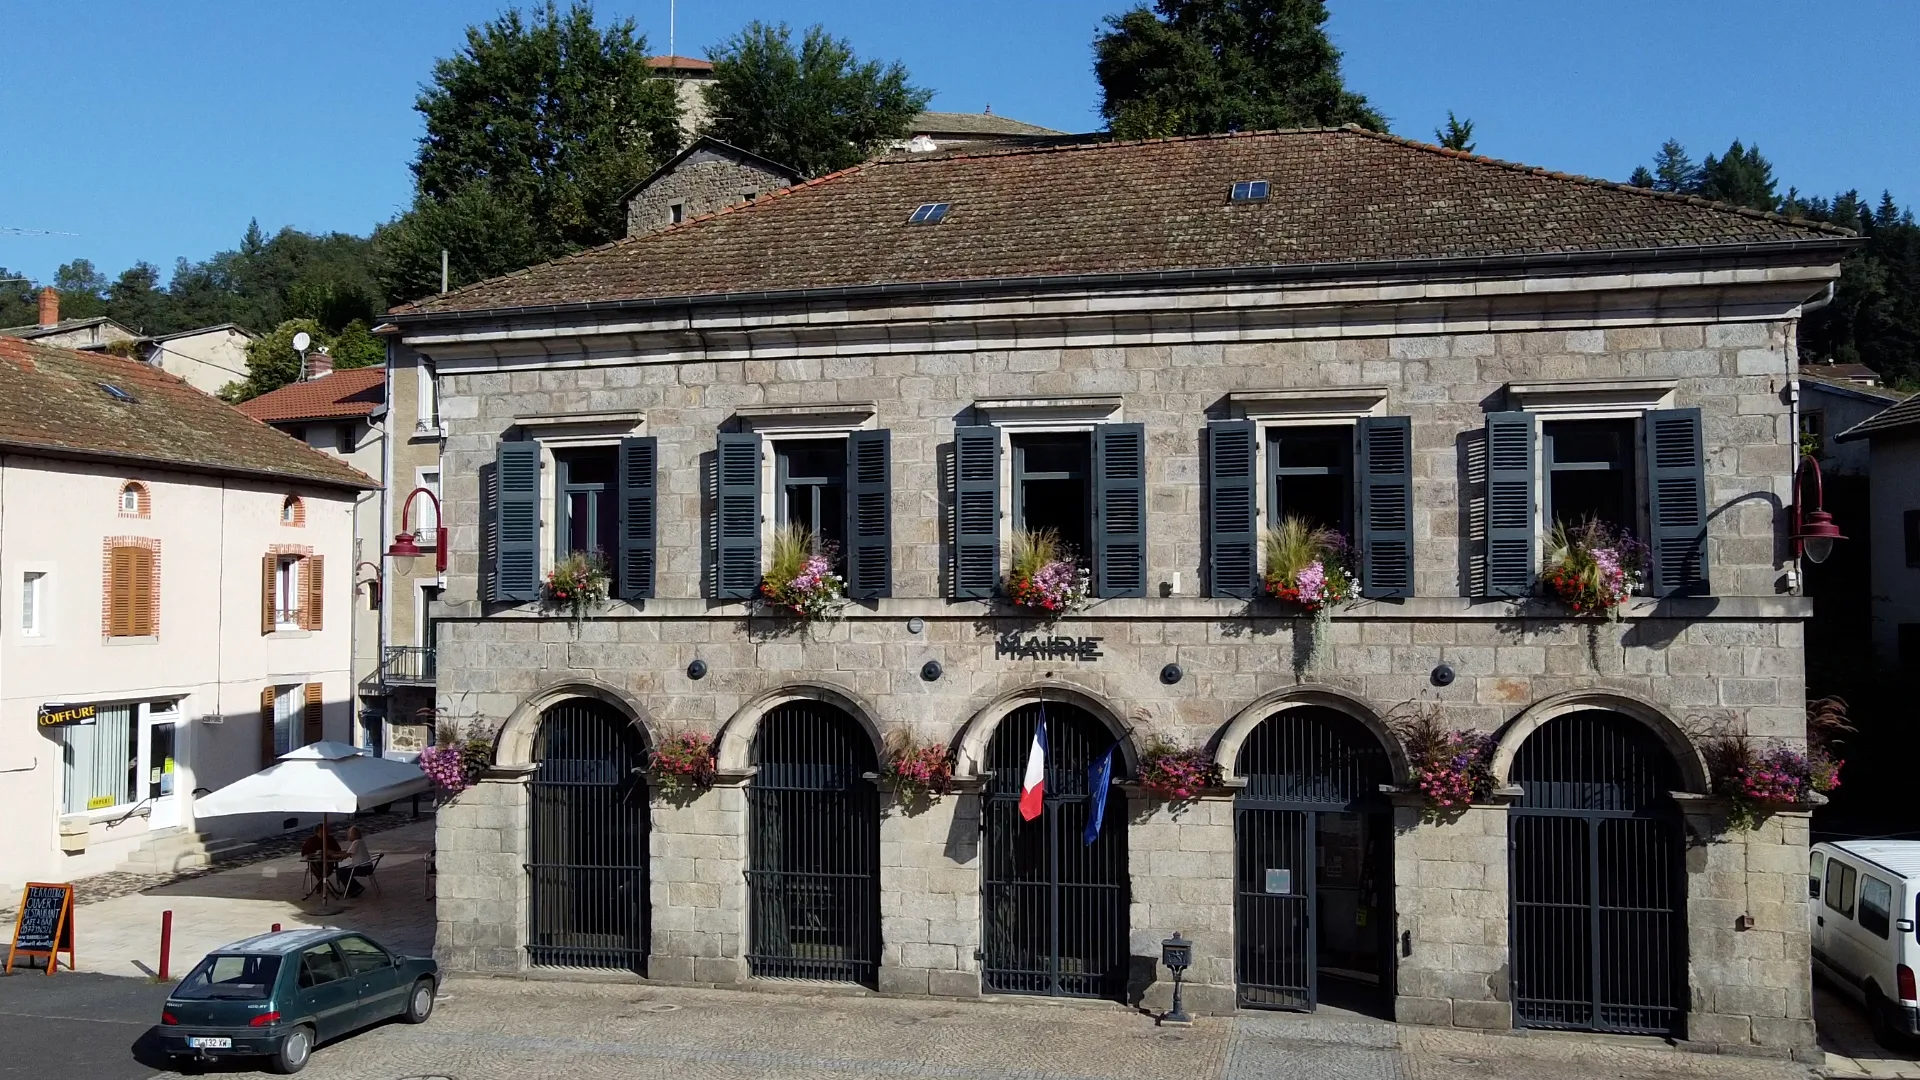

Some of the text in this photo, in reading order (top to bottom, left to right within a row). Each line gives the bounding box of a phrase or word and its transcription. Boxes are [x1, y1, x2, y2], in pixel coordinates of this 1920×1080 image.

[997, 635, 1104, 659] MAIRIE
[40, 706, 95, 726] COIFFURE
[26, 897, 59, 909] OUVERT
[205, 1038, 216, 1047] 132
